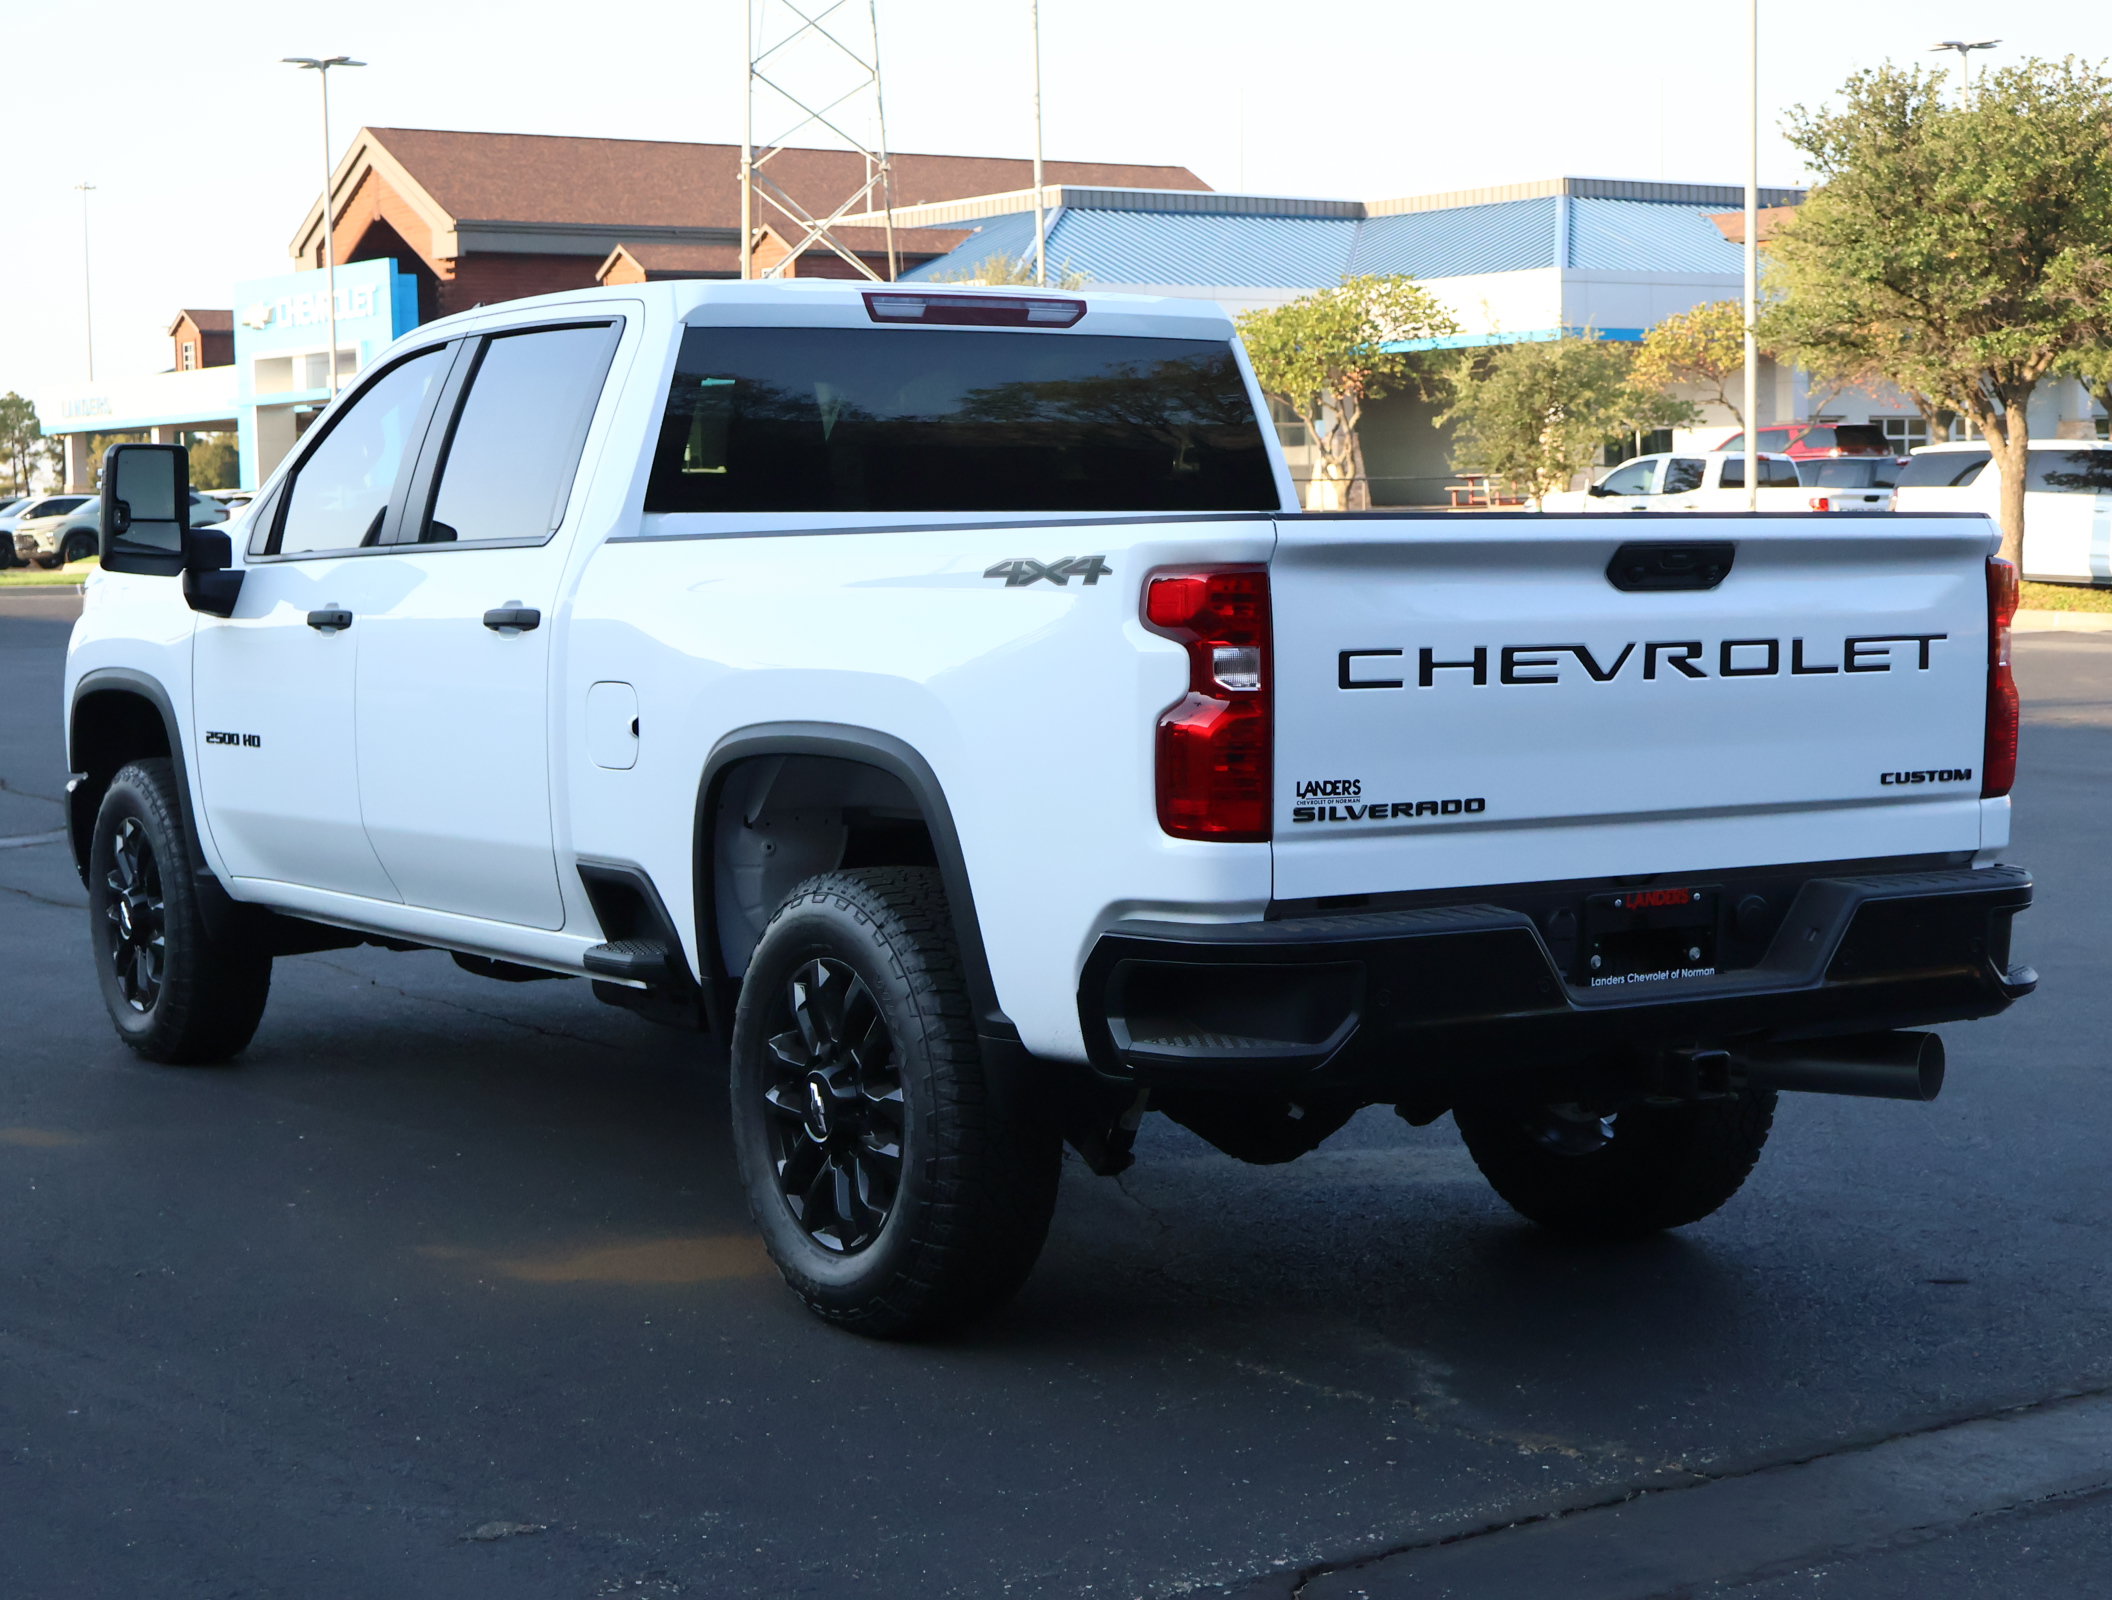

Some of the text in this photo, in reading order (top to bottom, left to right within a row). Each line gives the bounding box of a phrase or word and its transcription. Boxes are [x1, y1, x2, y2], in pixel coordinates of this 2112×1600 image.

[1338, 634, 1948, 690] CHEVROLET
[206, 731, 261, 748] 2500 HD
[1880, 769, 1972, 785] CUSTOM
[1296, 779, 1361, 799] LANDERS
[1293, 797, 1486, 823] SILVERADO
[1625, 888, 1690, 910] LANDERS
[1591, 967, 1715, 987] Landers Chevrolet of Norman
